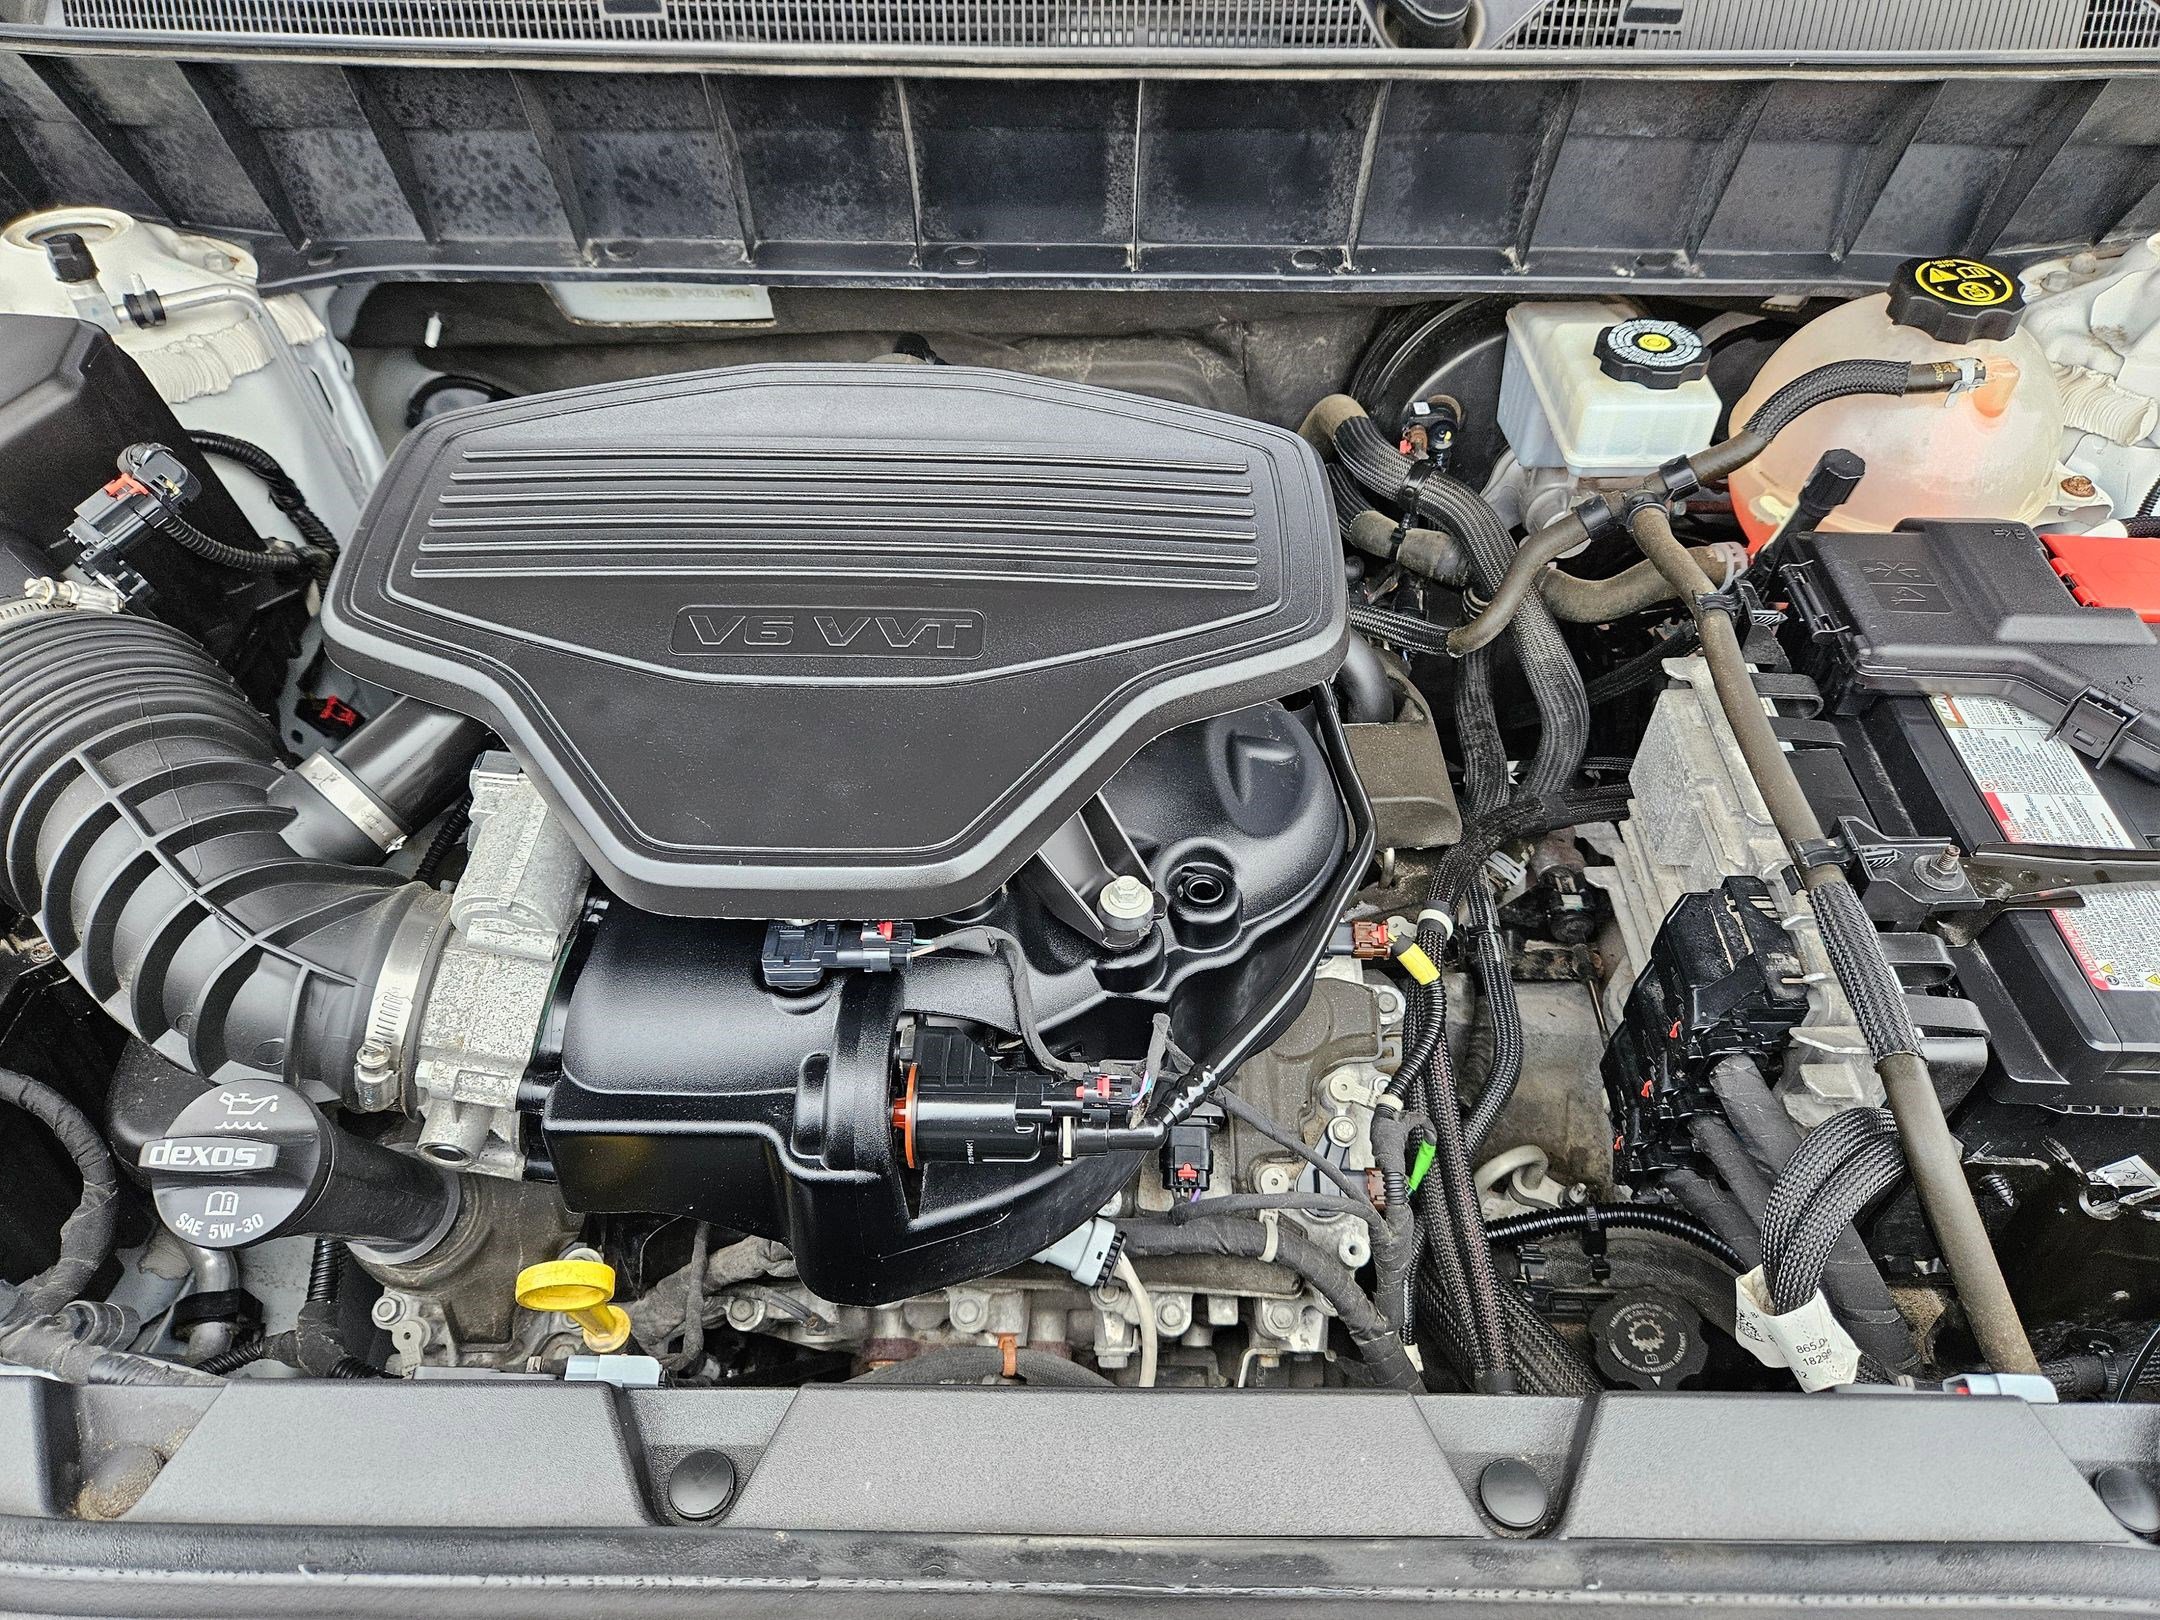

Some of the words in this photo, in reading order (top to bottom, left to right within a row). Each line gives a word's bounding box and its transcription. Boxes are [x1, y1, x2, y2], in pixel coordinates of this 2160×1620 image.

[688, 615, 794, 646] V6
[814, 616, 973, 648] VVT
[148, 1140, 258, 1167] dexos
[175, 1212, 204, 1237] SAE
[208, 1213, 264, 1239] 5W-30
